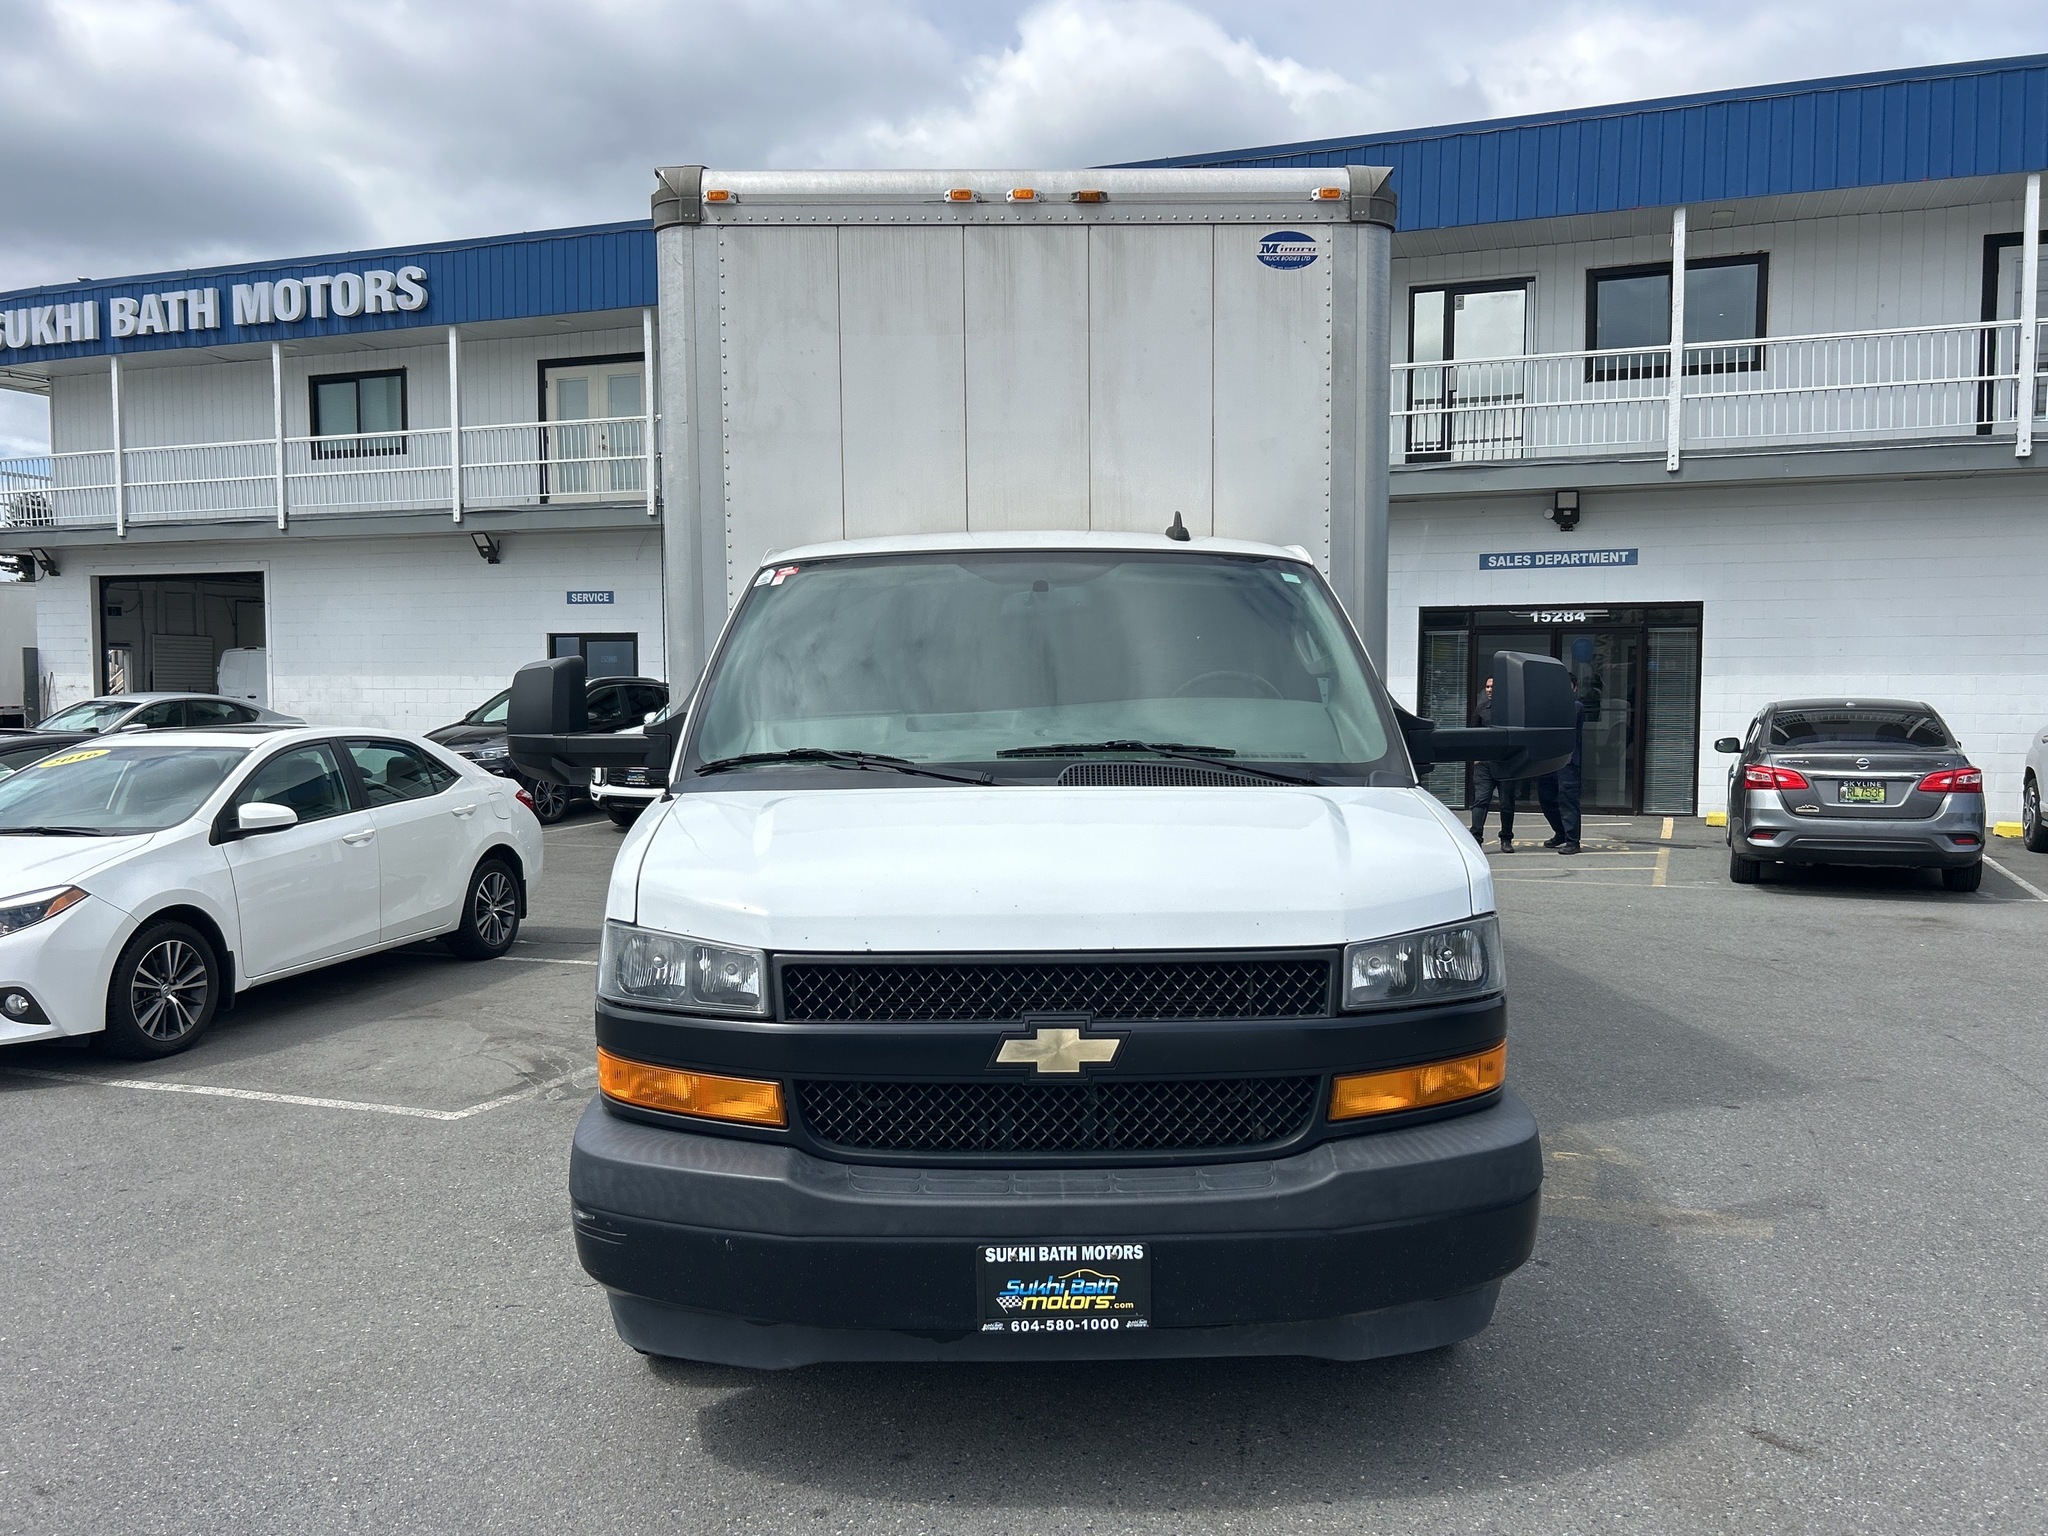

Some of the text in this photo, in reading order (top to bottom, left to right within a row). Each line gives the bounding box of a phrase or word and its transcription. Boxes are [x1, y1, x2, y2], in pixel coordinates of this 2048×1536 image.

[0, 265, 429, 350] UKHI BATH MOTORS
[1488, 551, 1629, 567] SALES DEPARTMENT
[571, 593, 609, 602] SERVICE
[1530, 610, 1586, 623] 15284
[985, 1245, 1144, 1263] SUKHI BATH MOTORS
[1000, 1276, 1119, 1296] Sukhi Bath
[1011, 1318, 1119, 1332] 604-580-1000
